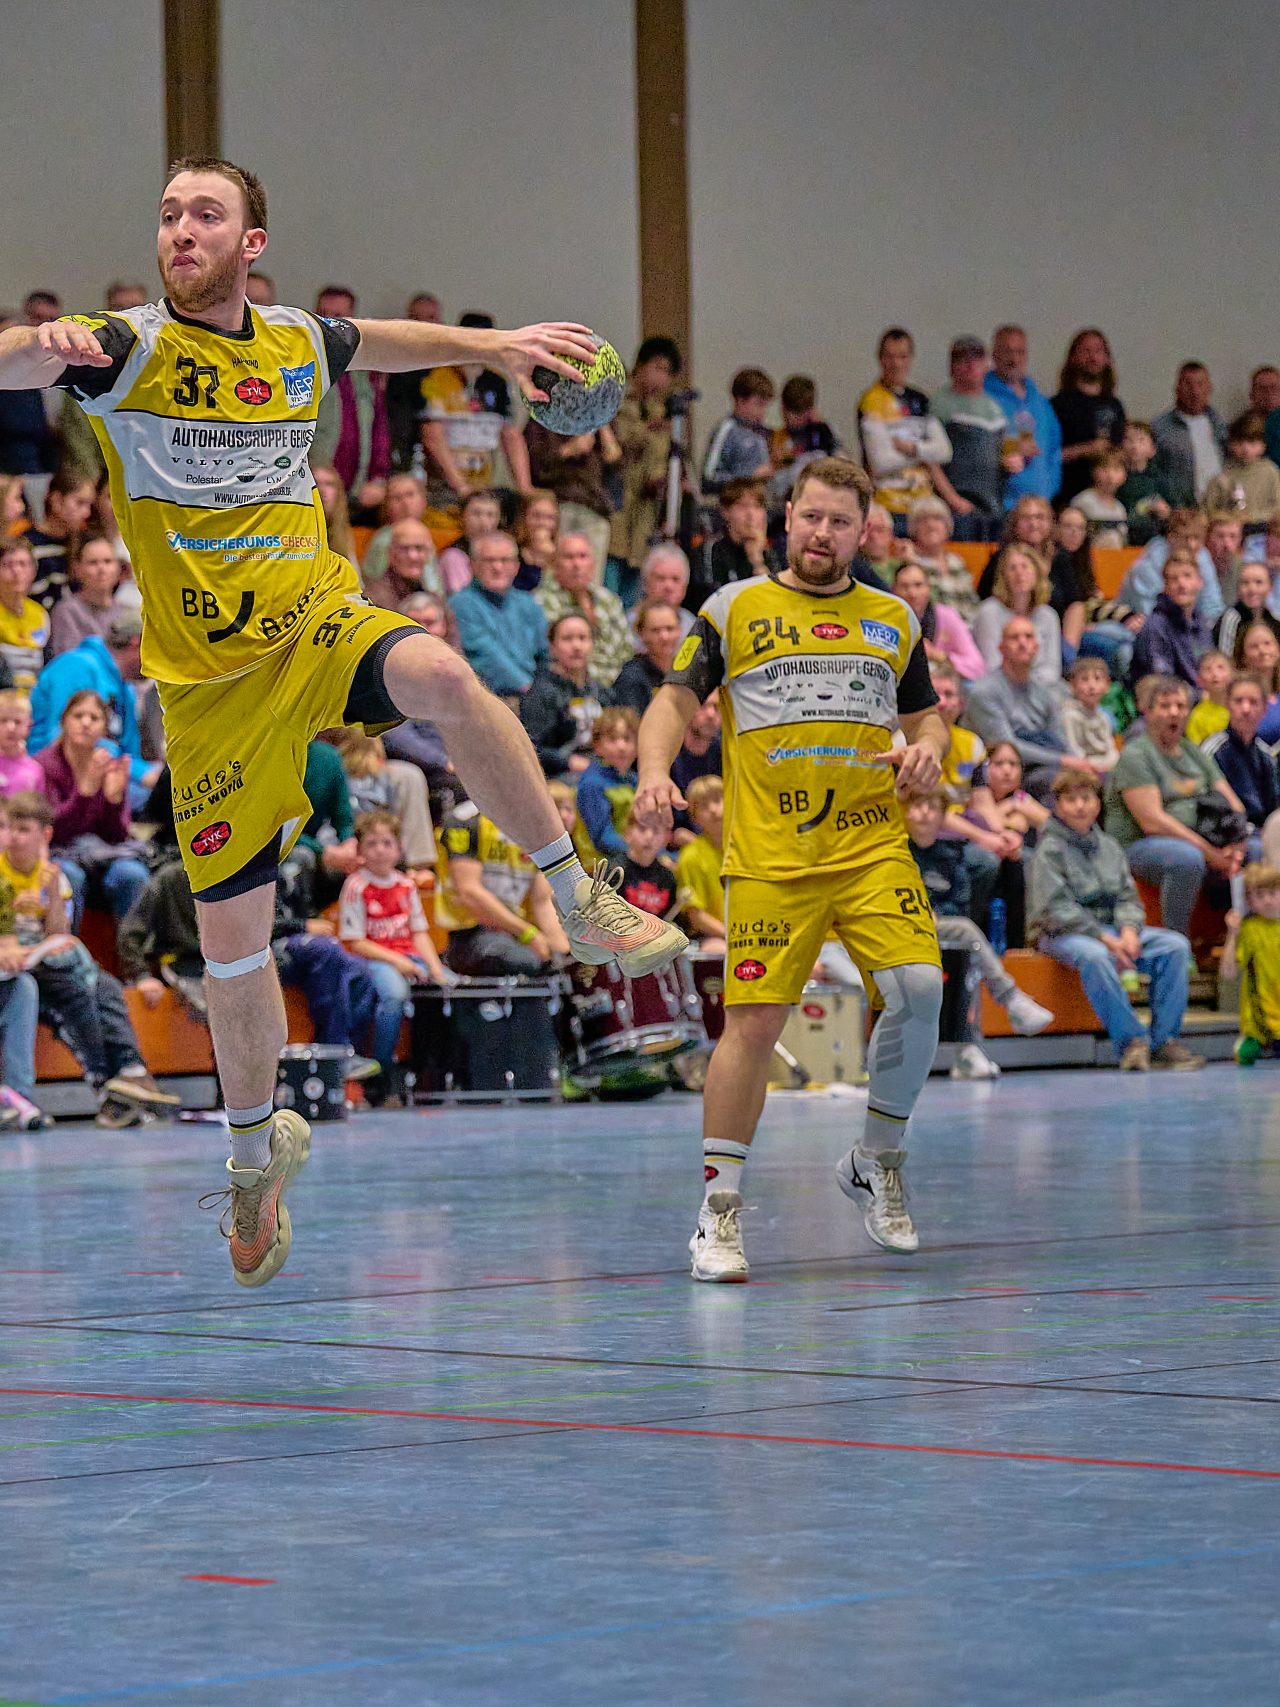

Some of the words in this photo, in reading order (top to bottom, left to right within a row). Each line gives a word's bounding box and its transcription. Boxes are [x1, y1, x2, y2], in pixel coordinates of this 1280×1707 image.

[173, 355, 220, 409] 37
[287, 376, 314, 396] MER
[172, 426, 288, 449] AUTOHAUSGRUPPE
[171, 456, 234, 466] VOLVO
[186, 473, 224, 485] Polestar
[224, 554, 238, 563] Die
[239, 552, 266, 561] besten
[181, 587, 220, 620] BB
[748, 616, 801, 655] 24
[764, 660, 862, 682] AUTOHAUSGRUPPE
[779, 790, 810, 815] BB
[836, 803, 890, 831] Bank
[202, 829, 224, 848] TVK
[894, 887, 934, 919] 24
[758, 937, 790, 947] World
